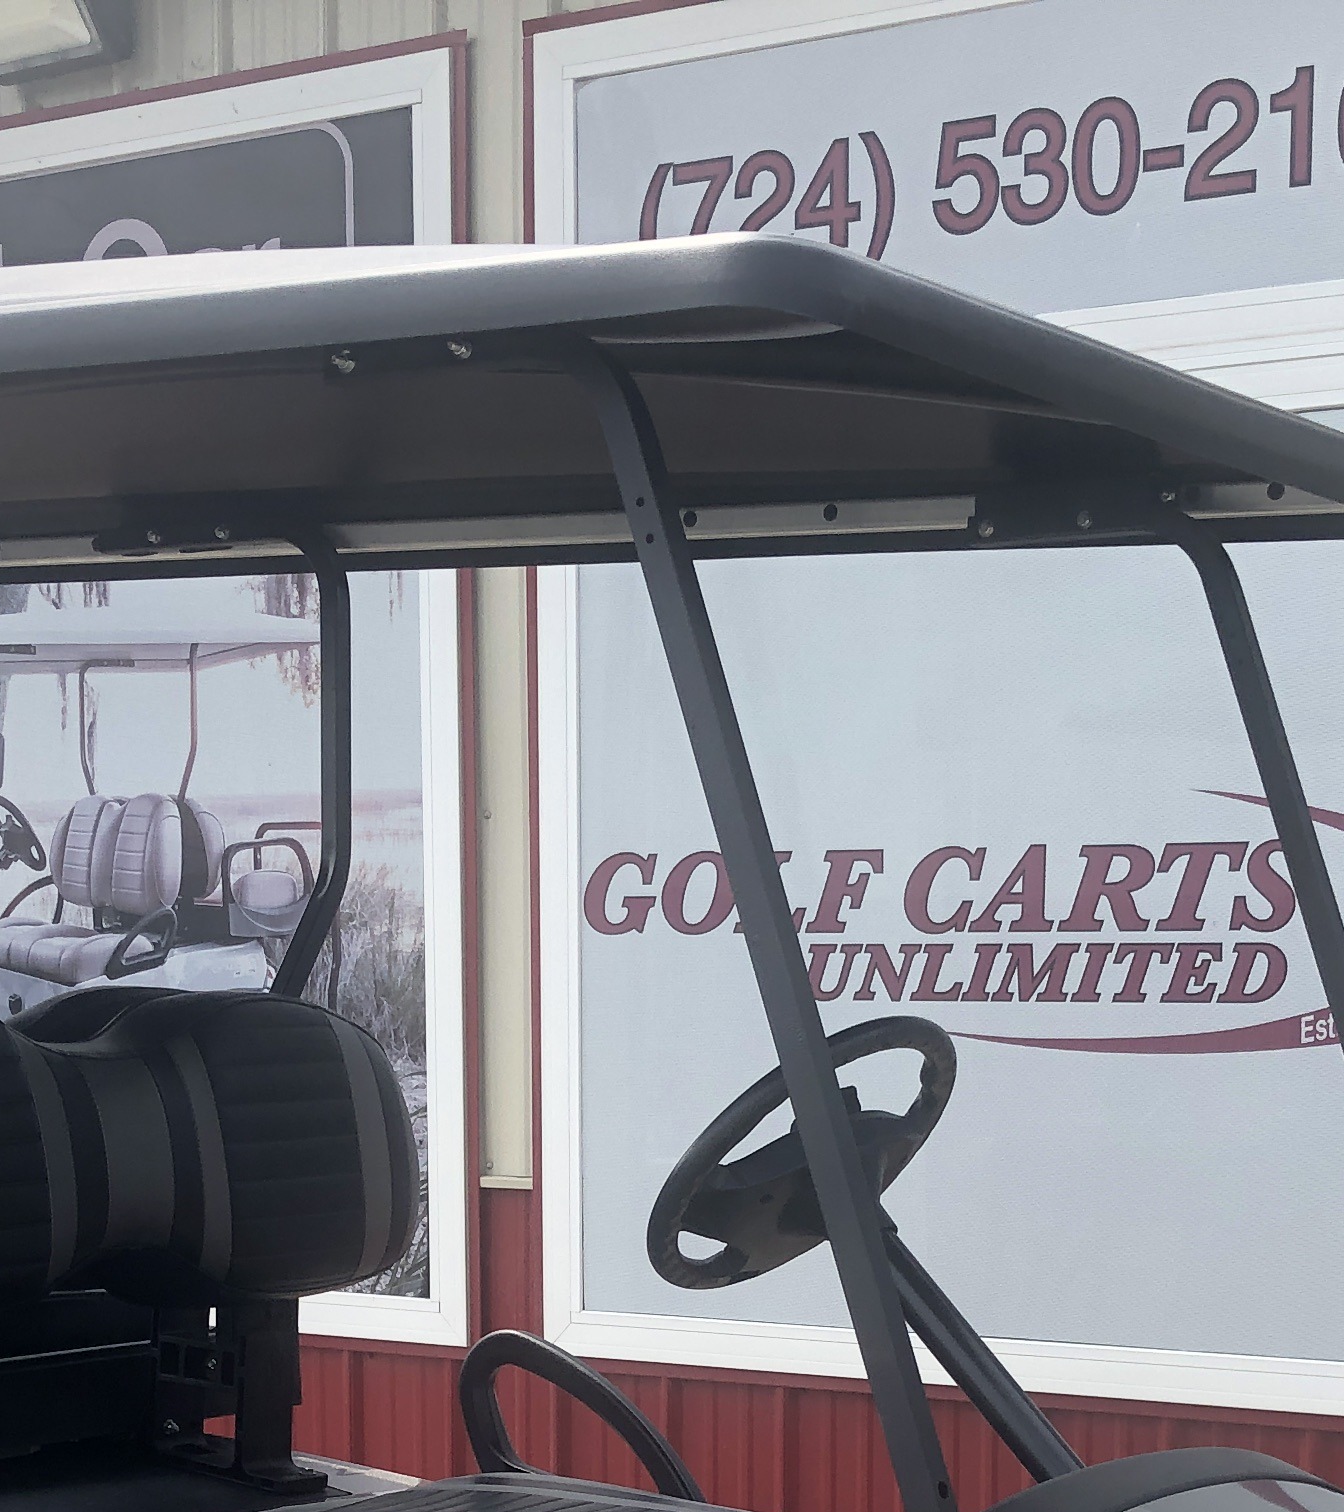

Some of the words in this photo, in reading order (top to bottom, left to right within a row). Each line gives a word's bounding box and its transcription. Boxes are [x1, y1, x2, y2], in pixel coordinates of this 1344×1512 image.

[638, 130, 896, 262] (724)
[903, 838, 1297, 935] CARTS
[807, 942, 1289, 1004] UNLIMITED
